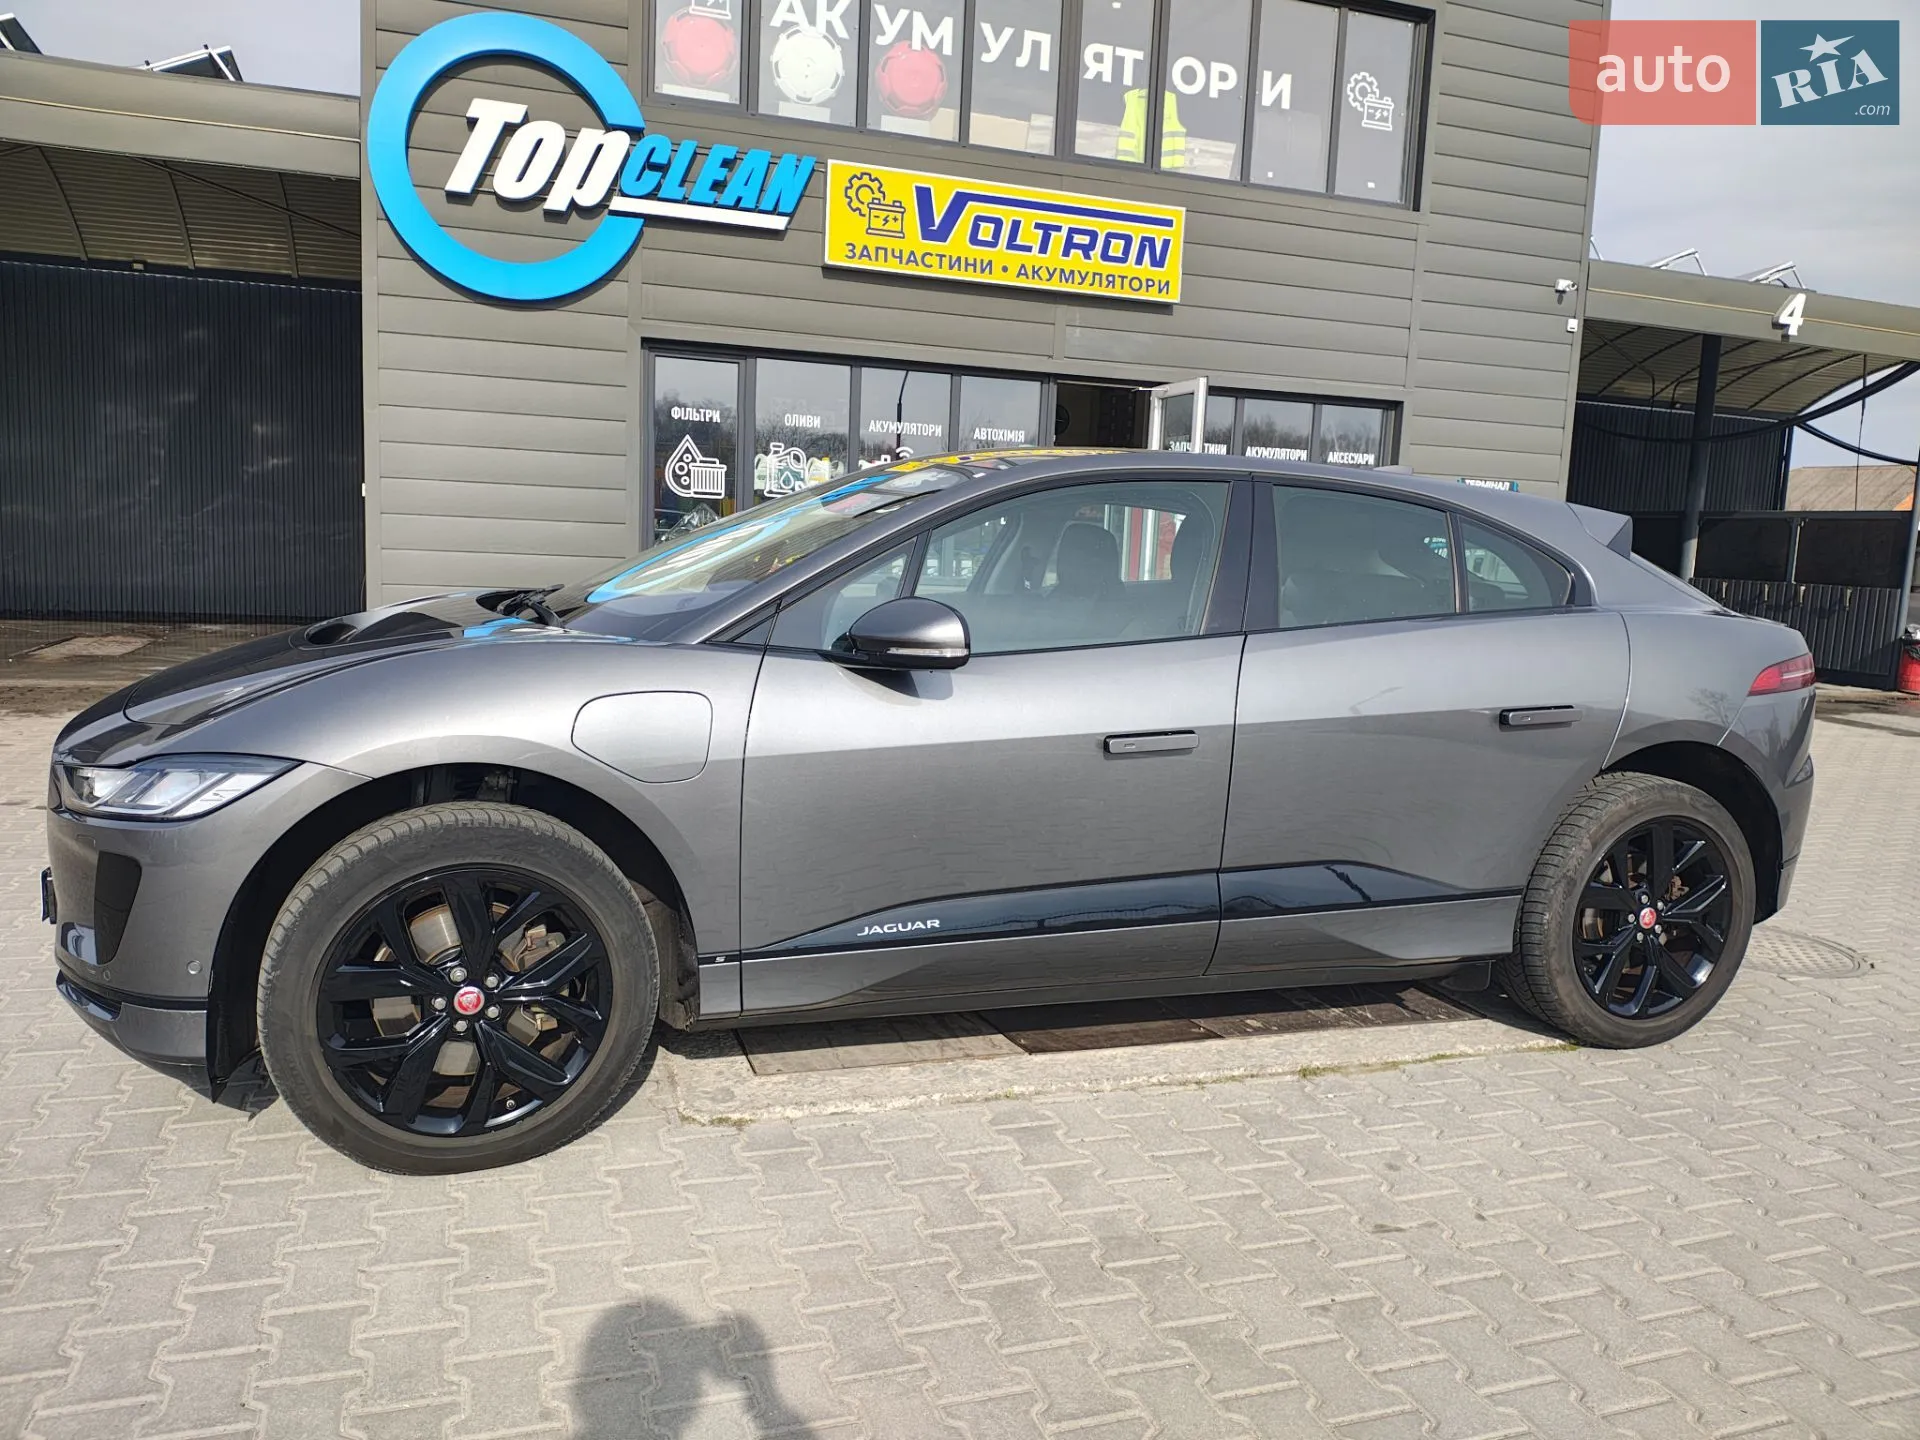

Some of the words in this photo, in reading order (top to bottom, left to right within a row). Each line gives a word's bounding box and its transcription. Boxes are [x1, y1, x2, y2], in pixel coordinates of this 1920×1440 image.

[913, 185, 1173, 269] VOLTRON
[844, 243, 994, 276] ЗАПЧАСТИНИ
[1016, 263, 1171, 295] АКУМУЛЯТОРИ
[1778, 292, 1807, 336] 4
[671, 406, 721, 423] ФІЛЬТРИ
[784, 413, 821, 428] ОЛИВИ
[868, 419, 943, 437] АКУМУЛЯТОРИ
[973, 427, 1025, 443] АВТОХІМІЯ
[1245, 446, 1308, 462] АКУМУЛЯТОРИ
[1327, 452, 1375, 465] АКСЕСУАРИ
[856, 919, 940, 936] JAGUAR
